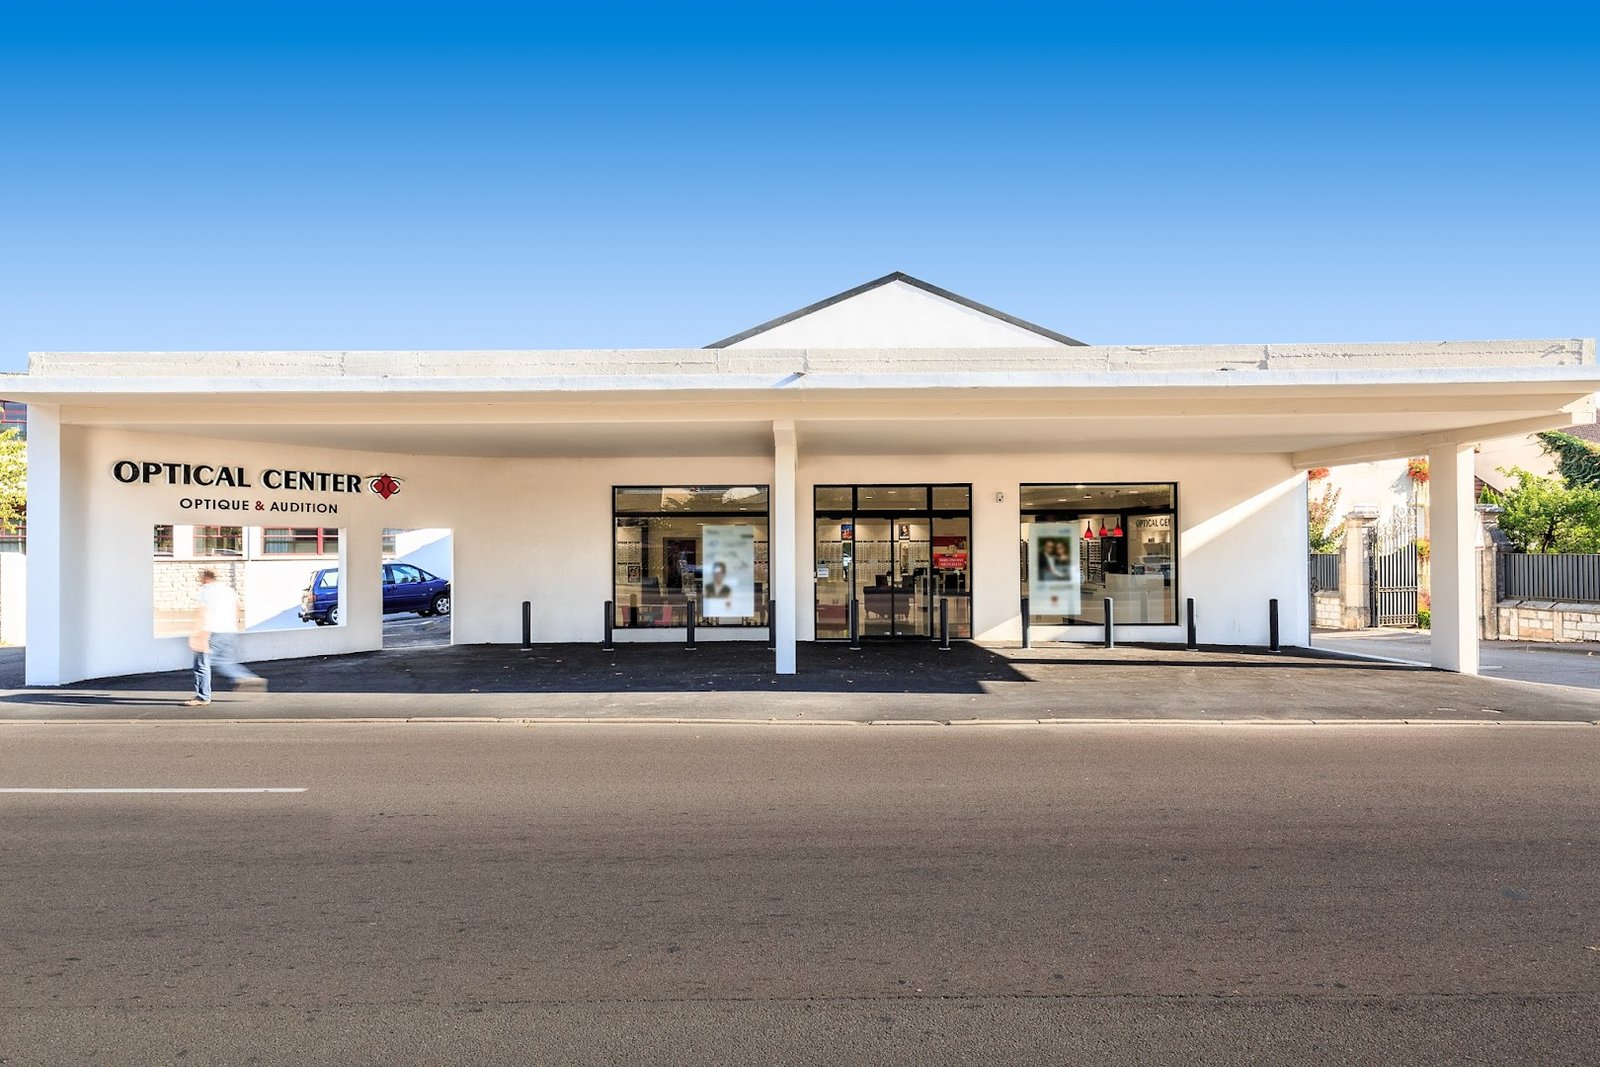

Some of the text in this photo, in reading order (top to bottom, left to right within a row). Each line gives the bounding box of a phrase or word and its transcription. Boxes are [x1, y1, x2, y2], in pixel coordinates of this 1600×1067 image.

[113, 461, 362, 493] OPTICAL CENTER
[179, 498, 338, 514] OPTIQUE & AUDITION
